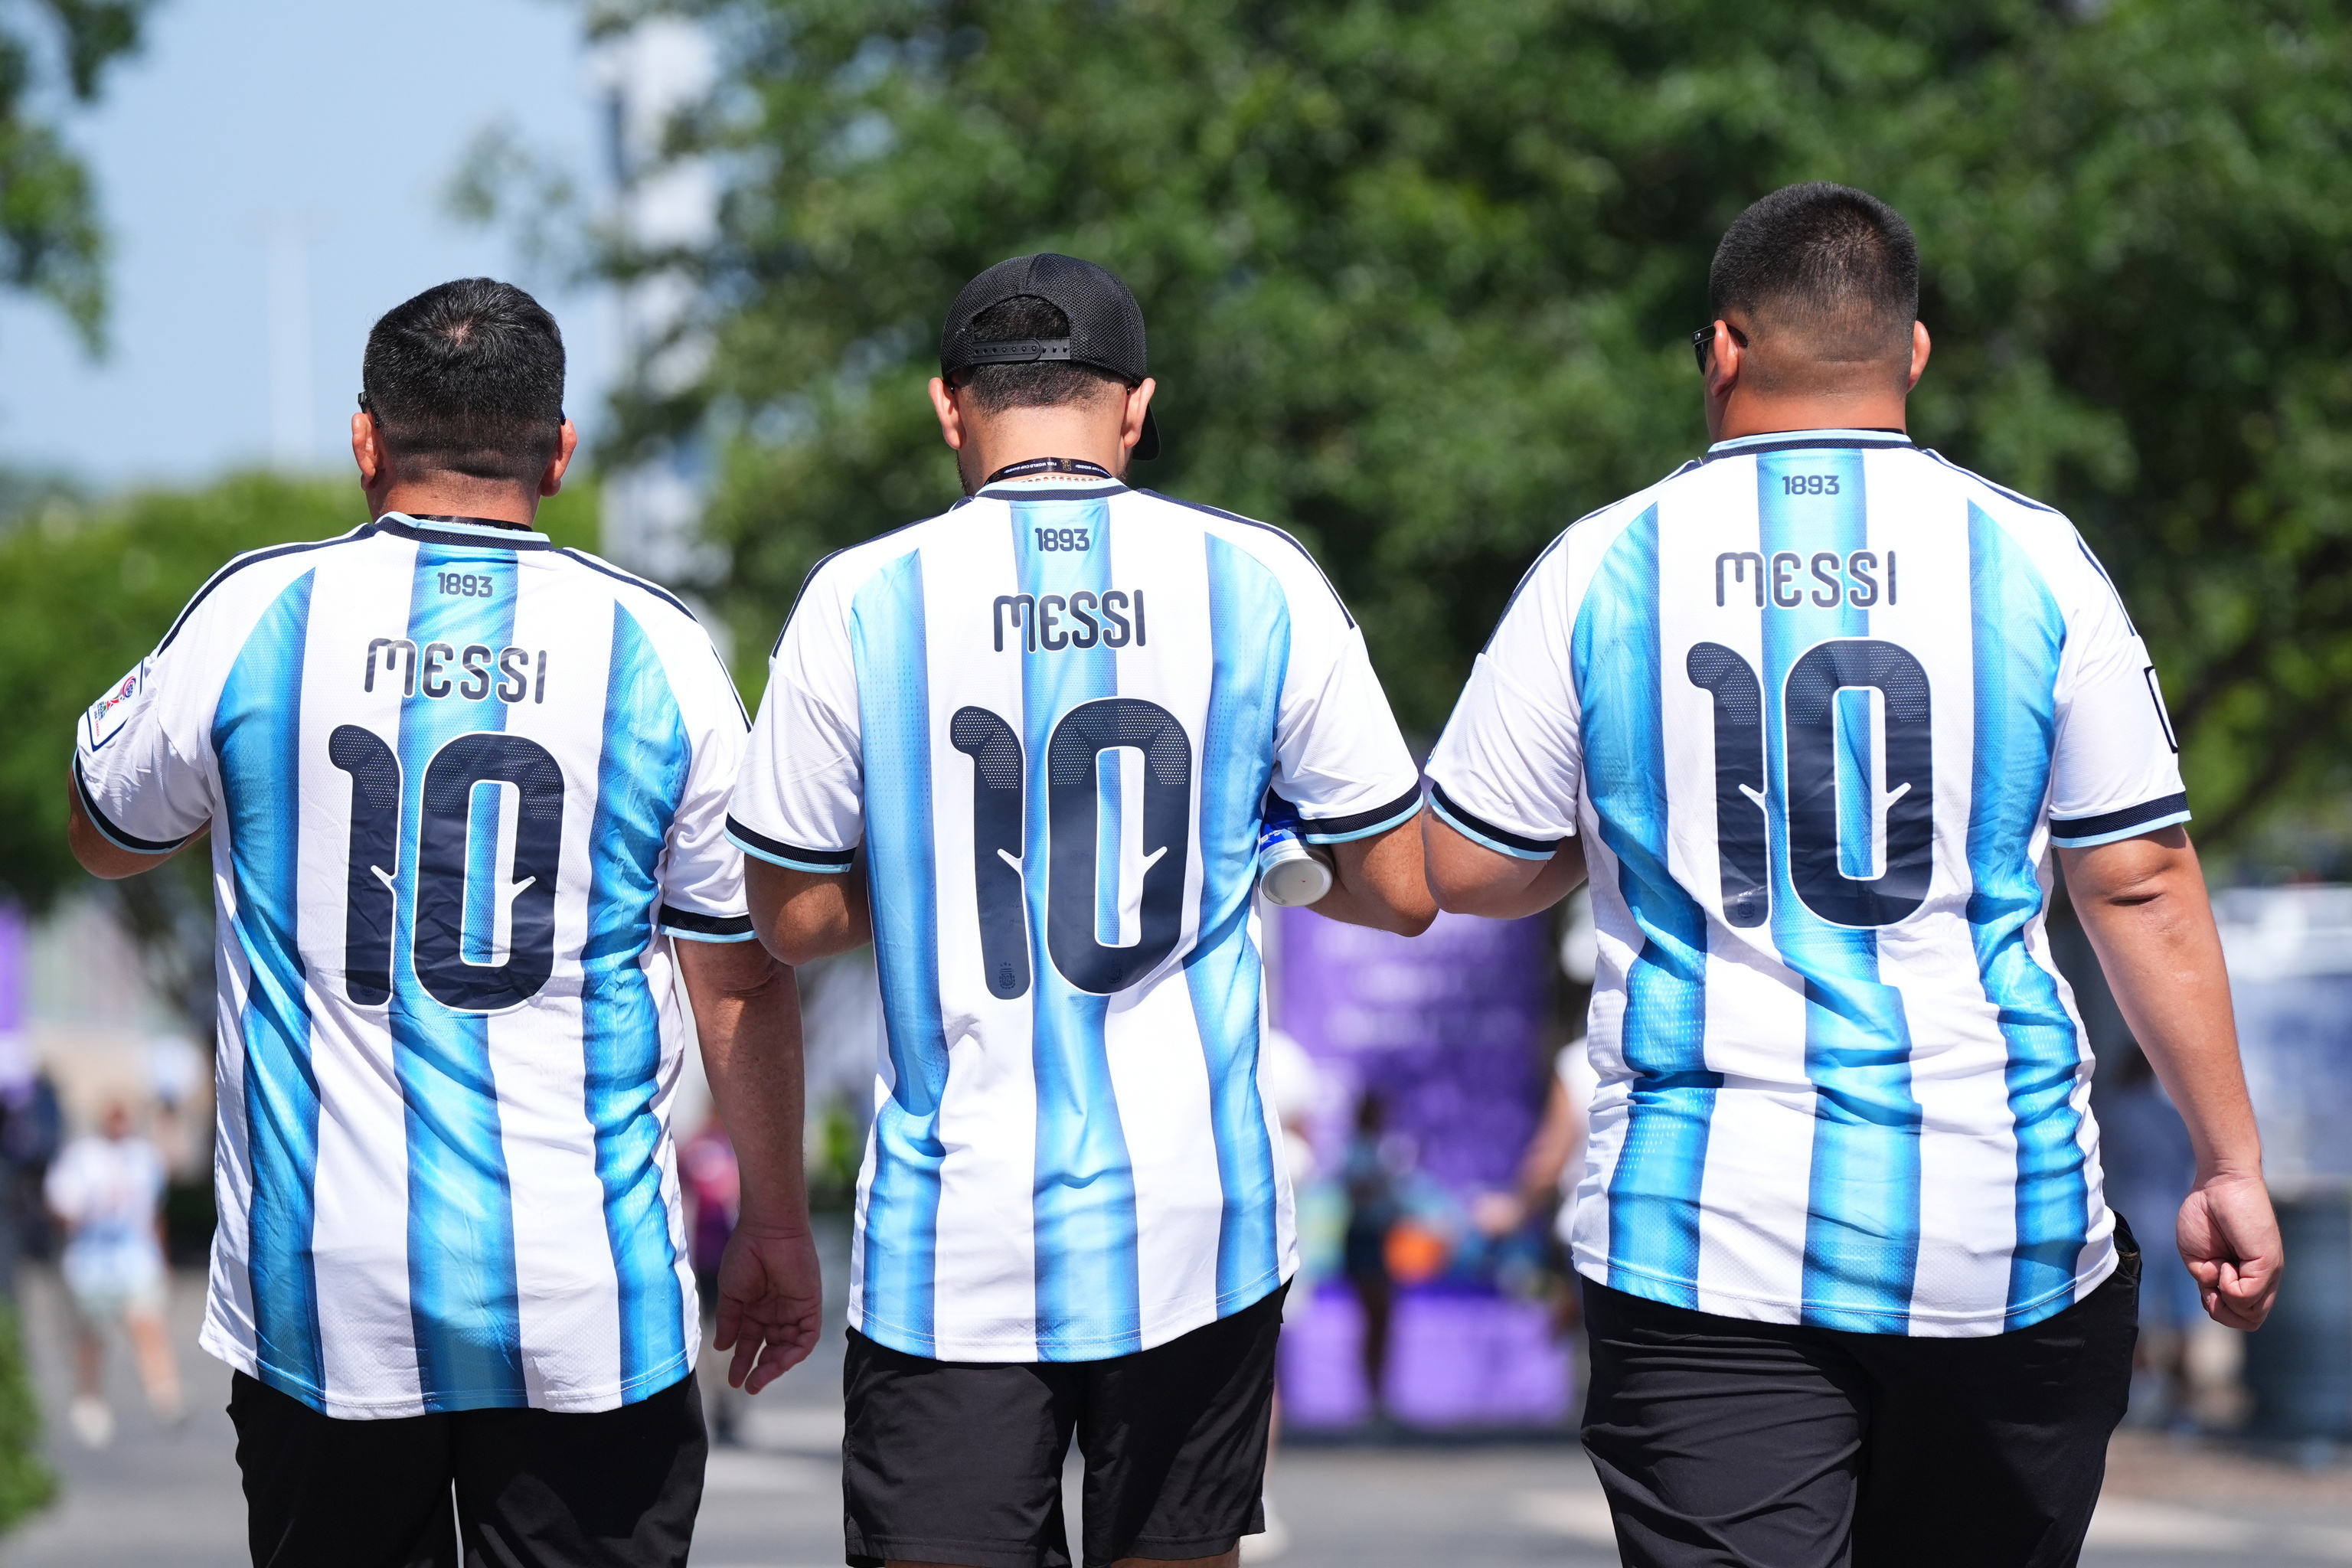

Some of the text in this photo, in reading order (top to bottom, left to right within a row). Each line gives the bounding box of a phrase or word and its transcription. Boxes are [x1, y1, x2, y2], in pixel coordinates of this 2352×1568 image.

[1782, 475, 1840, 495] 1893
[1035, 528, 1090, 552] 1893
[437, 572, 493, 598] 1893
[1715, 550, 1896, 608] MESSI
[993, 589, 1146, 652] MESSI
[364, 638, 547, 704] MESSI
[1687, 641, 1933, 927] 10
[328, 724, 564, 1010] 10
[950, 698, 1191, 1000] 10
